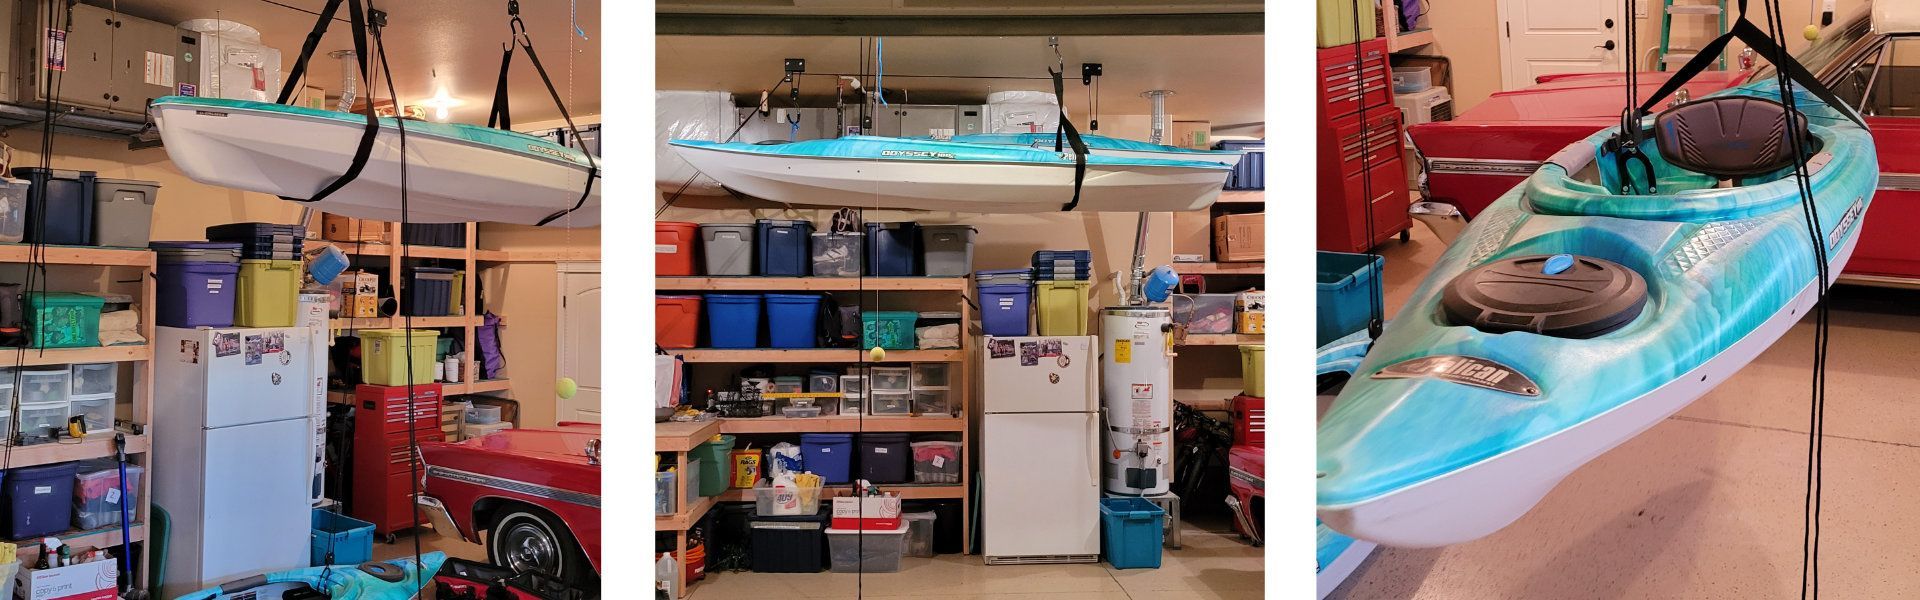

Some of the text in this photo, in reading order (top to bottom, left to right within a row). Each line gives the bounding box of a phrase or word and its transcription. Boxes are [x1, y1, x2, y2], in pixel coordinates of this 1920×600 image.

[881, 150, 937, 158] ODYSSEY
[36, 586, 51, 594] copy
[57, 583, 72, 592] print
